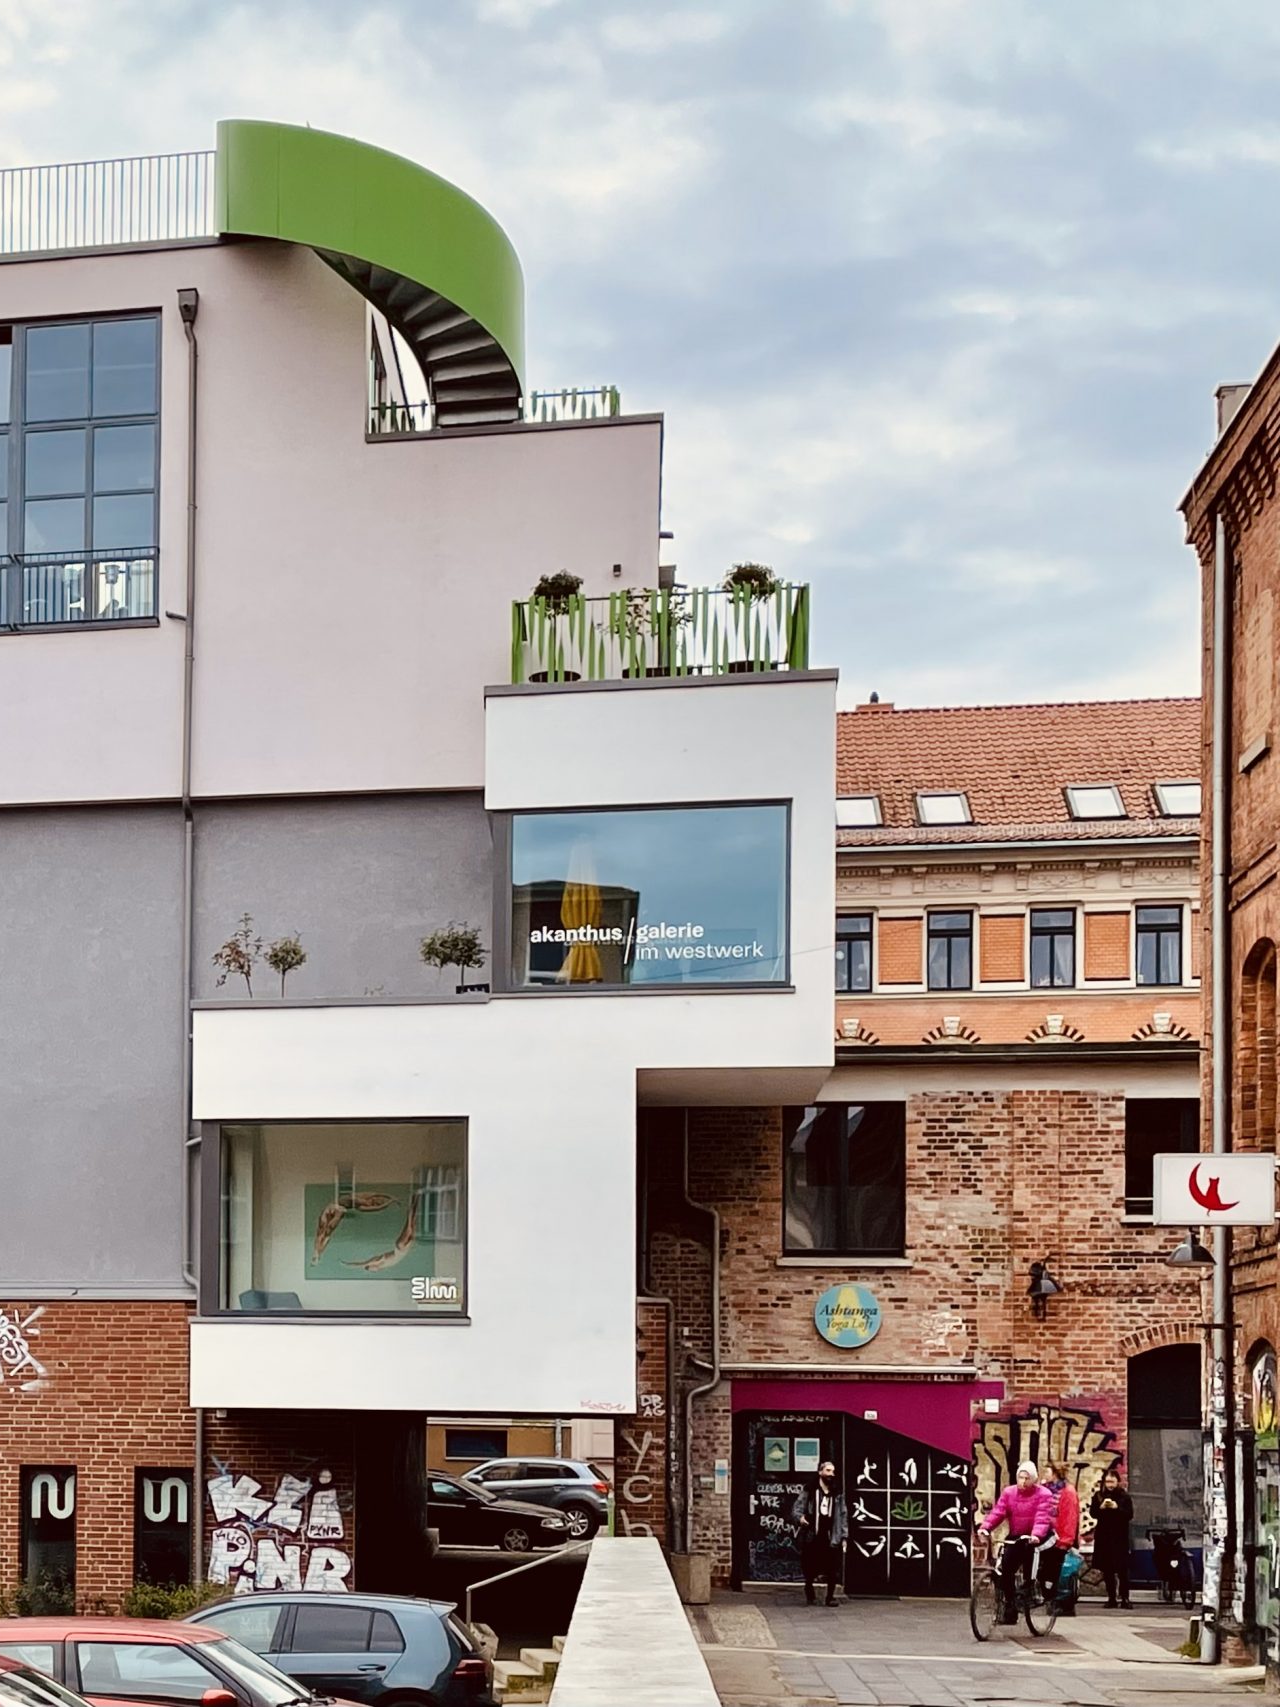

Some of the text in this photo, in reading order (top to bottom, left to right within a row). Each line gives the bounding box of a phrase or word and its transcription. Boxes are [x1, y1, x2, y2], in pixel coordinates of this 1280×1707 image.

[530, 922, 705, 943] akanthus galerie
[635, 941, 764, 960] im westwerk
[819, 1303, 879, 1321] Ashtanga
[825, 1317, 873, 1332] Yoga Loft
